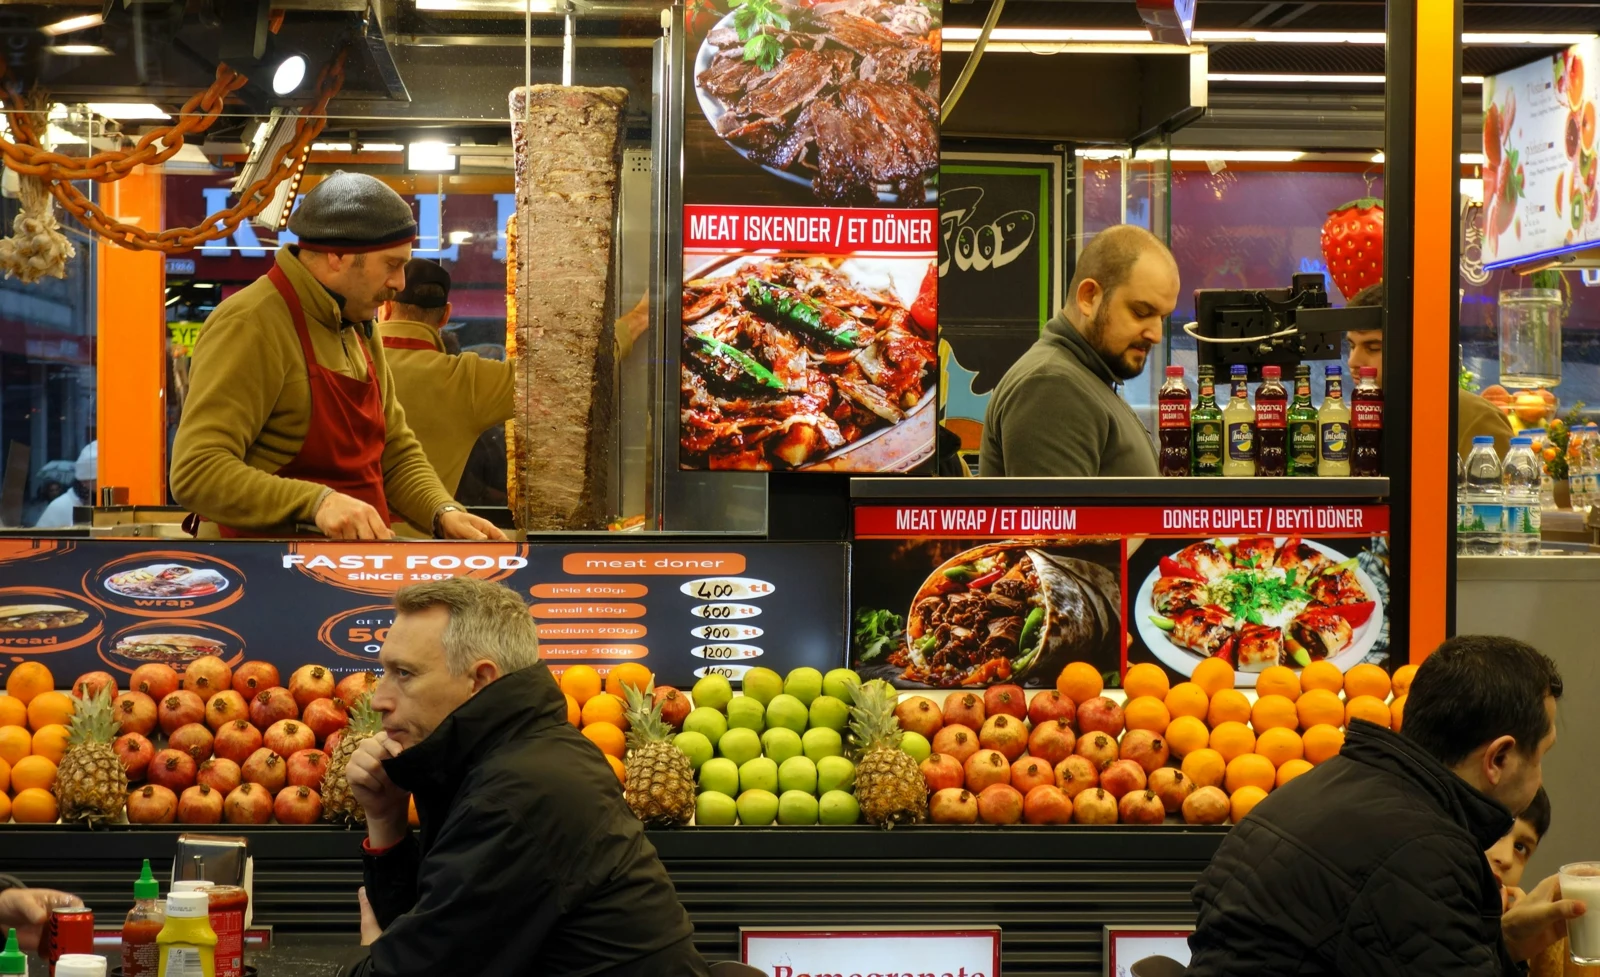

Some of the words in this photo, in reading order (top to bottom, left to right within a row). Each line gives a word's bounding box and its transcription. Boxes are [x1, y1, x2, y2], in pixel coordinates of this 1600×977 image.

[690, 215, 739, 240] MEAT
[743, 216, 830, 242] ISKENDER
[835, 215, 844, 247] /
[848, 218, 868, 243] ET
[871, 214, 932, 244] DÖNER
[896, 509, 937, 530] MEAT
[940, 509, 986, 530] WRAP
[989, 508, 998, 534] /
[1001, 509, 1018, 530] ET
[1021, 506, 1077, 530] DÜRÜM
[1163, 509, 1209, 529] DONER
[1212, 509, 1263, 529] CUPLET
[1266, 508, 1273, 531] /
[1276, 506, 1314, 528] BEYTİ
[1317, 505, 1363, 528] DÖNER
[282, 554, 393, 569] FAST
[405, 555, 529, 569] FOOD
[586, 558, 647, 568] meat
[654, 558, 724, 568] doner
[347, 571, 404, 581] SİNCE
[410, 573, 454, 581] 1967
[697, 581, 733, 599] 400
[748, 583, 770, 593] tl
[134, 600, 195, 608] wrap
[547, 606, 582, 614] small
[702, 604, 731, 619] 600
[703, 625, 730, 640] 800
[702, 645, 732, 659] 1200
